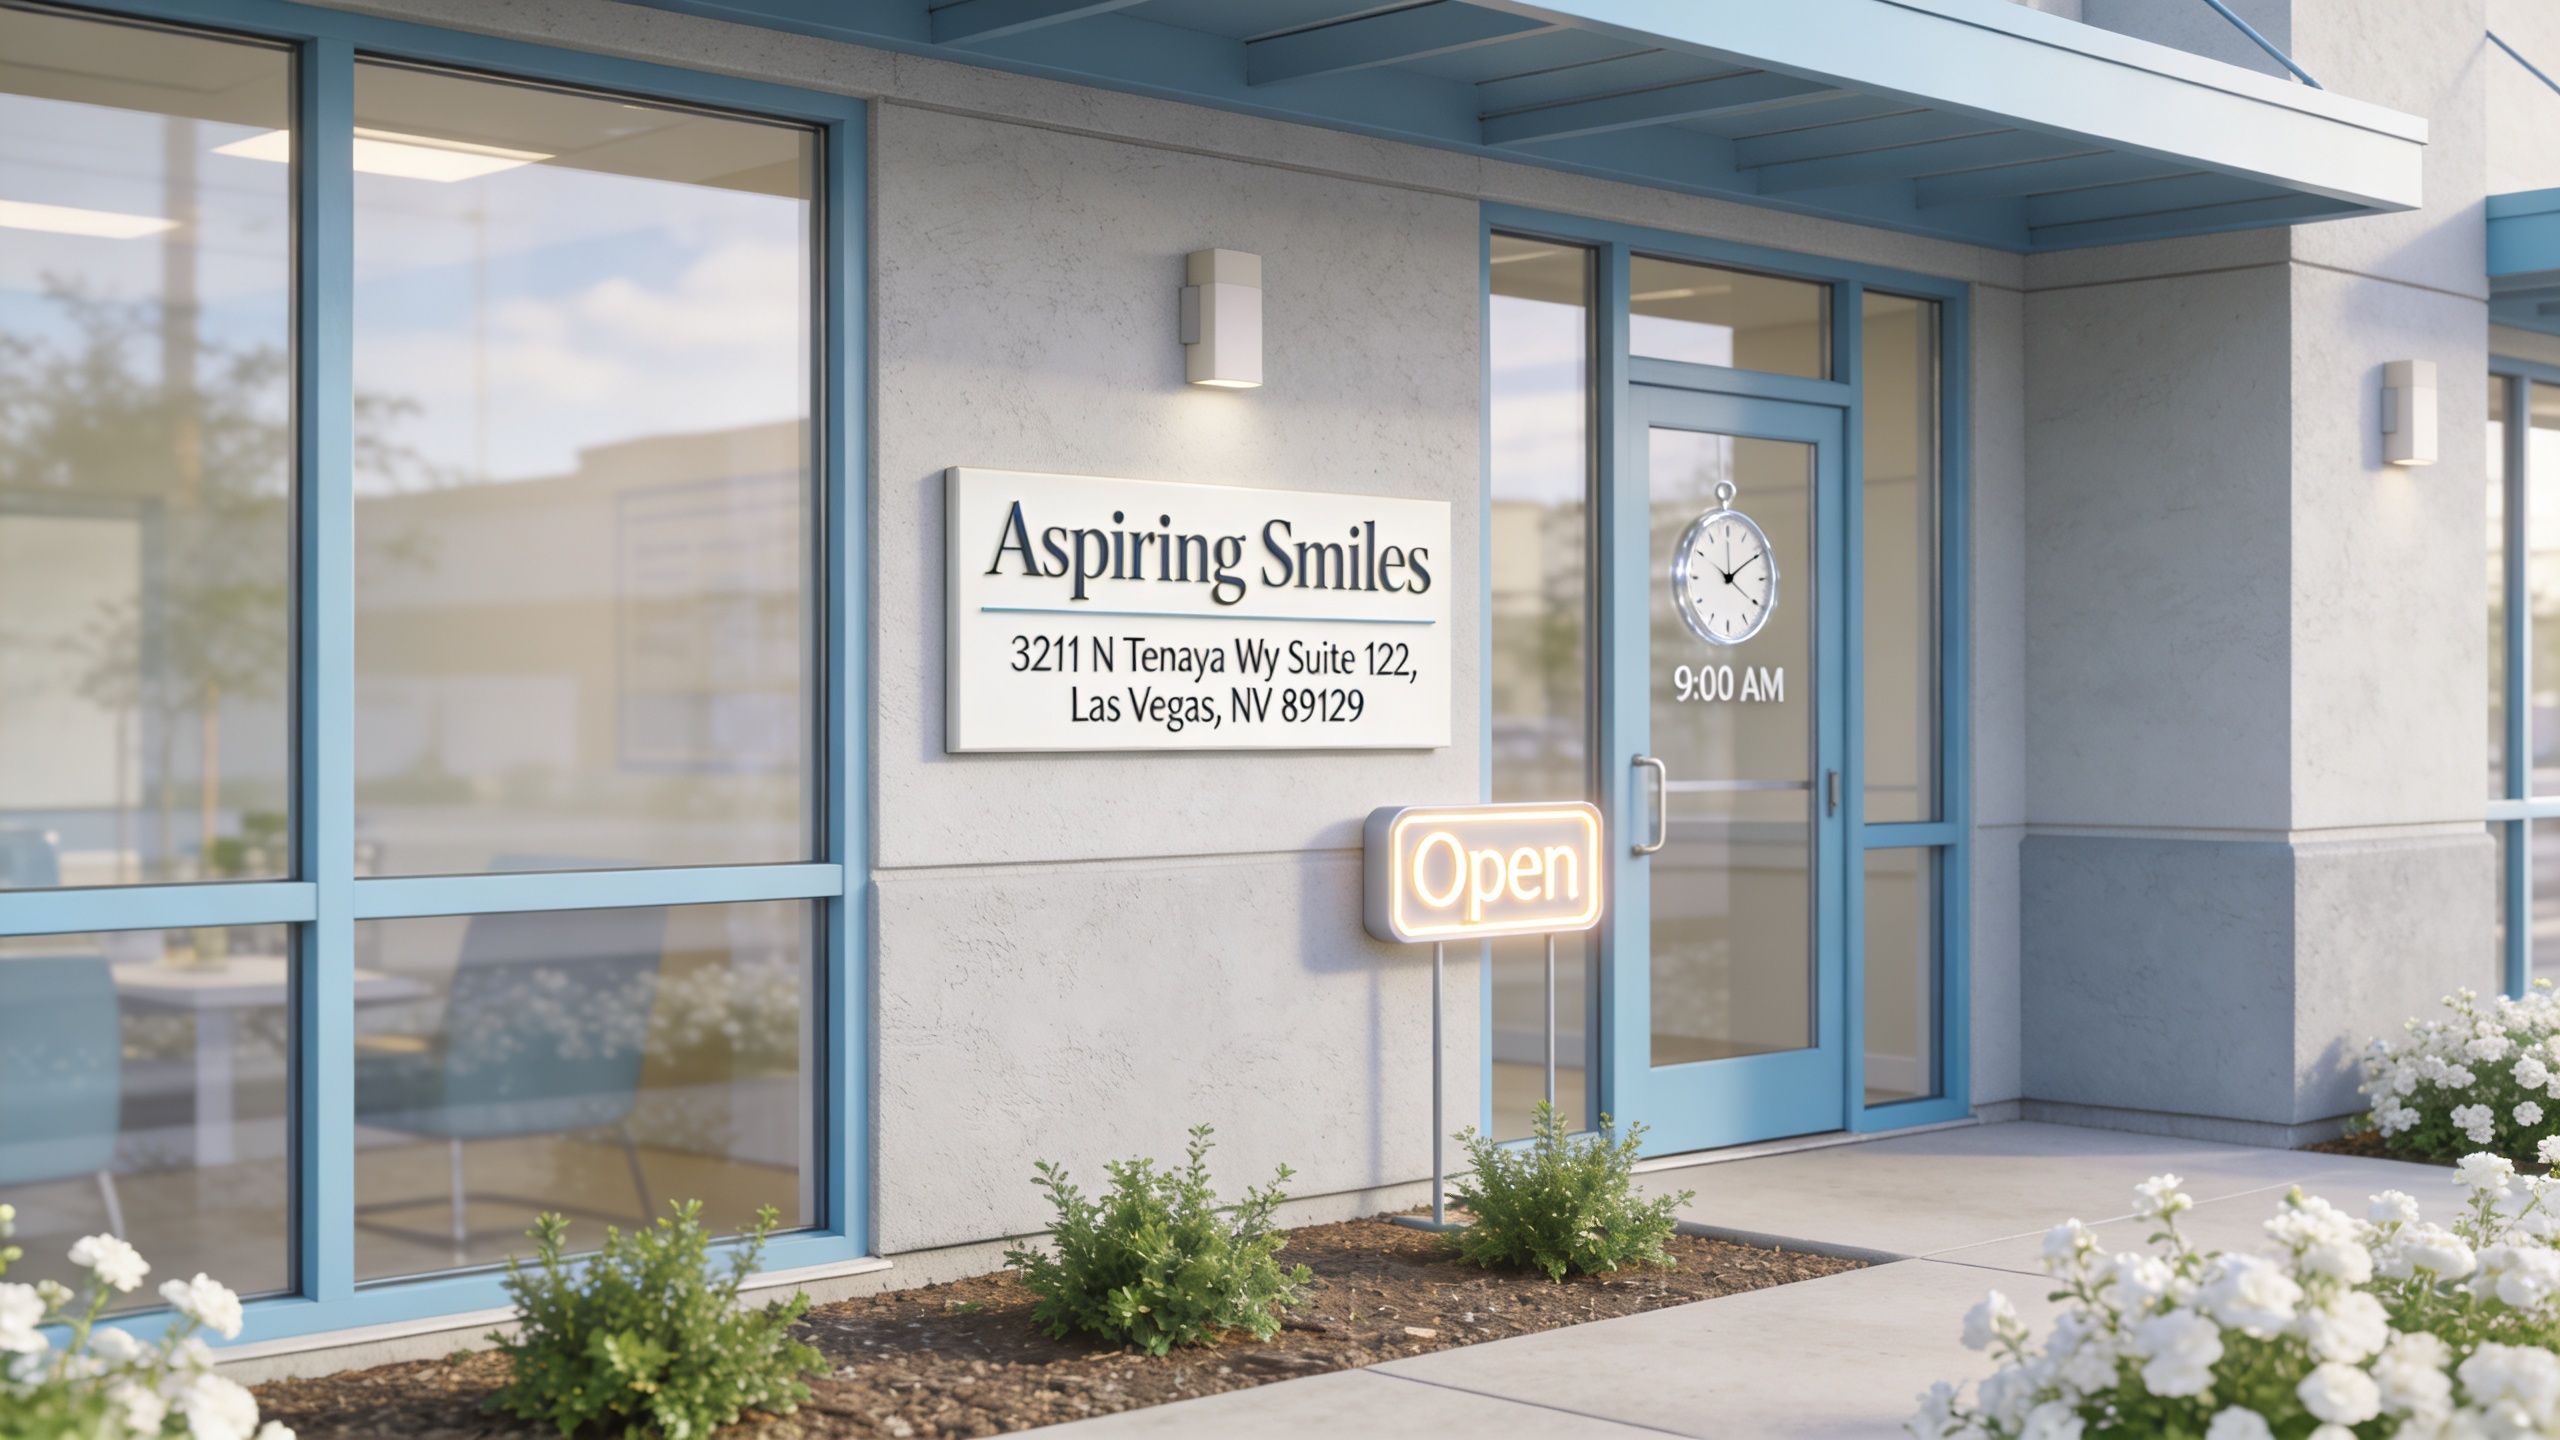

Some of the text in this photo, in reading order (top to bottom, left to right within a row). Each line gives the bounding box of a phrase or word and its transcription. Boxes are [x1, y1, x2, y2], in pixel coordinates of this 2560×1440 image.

[983, 500, 1432, 606] Aspiring Smiles
[1010, 634, 1418, 683] 3211 N Tenaya Wy Suite 122,
[1673, 664, 1785, 703] 9:00 AM
[1070, 686, 1365, 733] Las Vegas, NV 89129
[1412, 830, 1580, 923] Open
